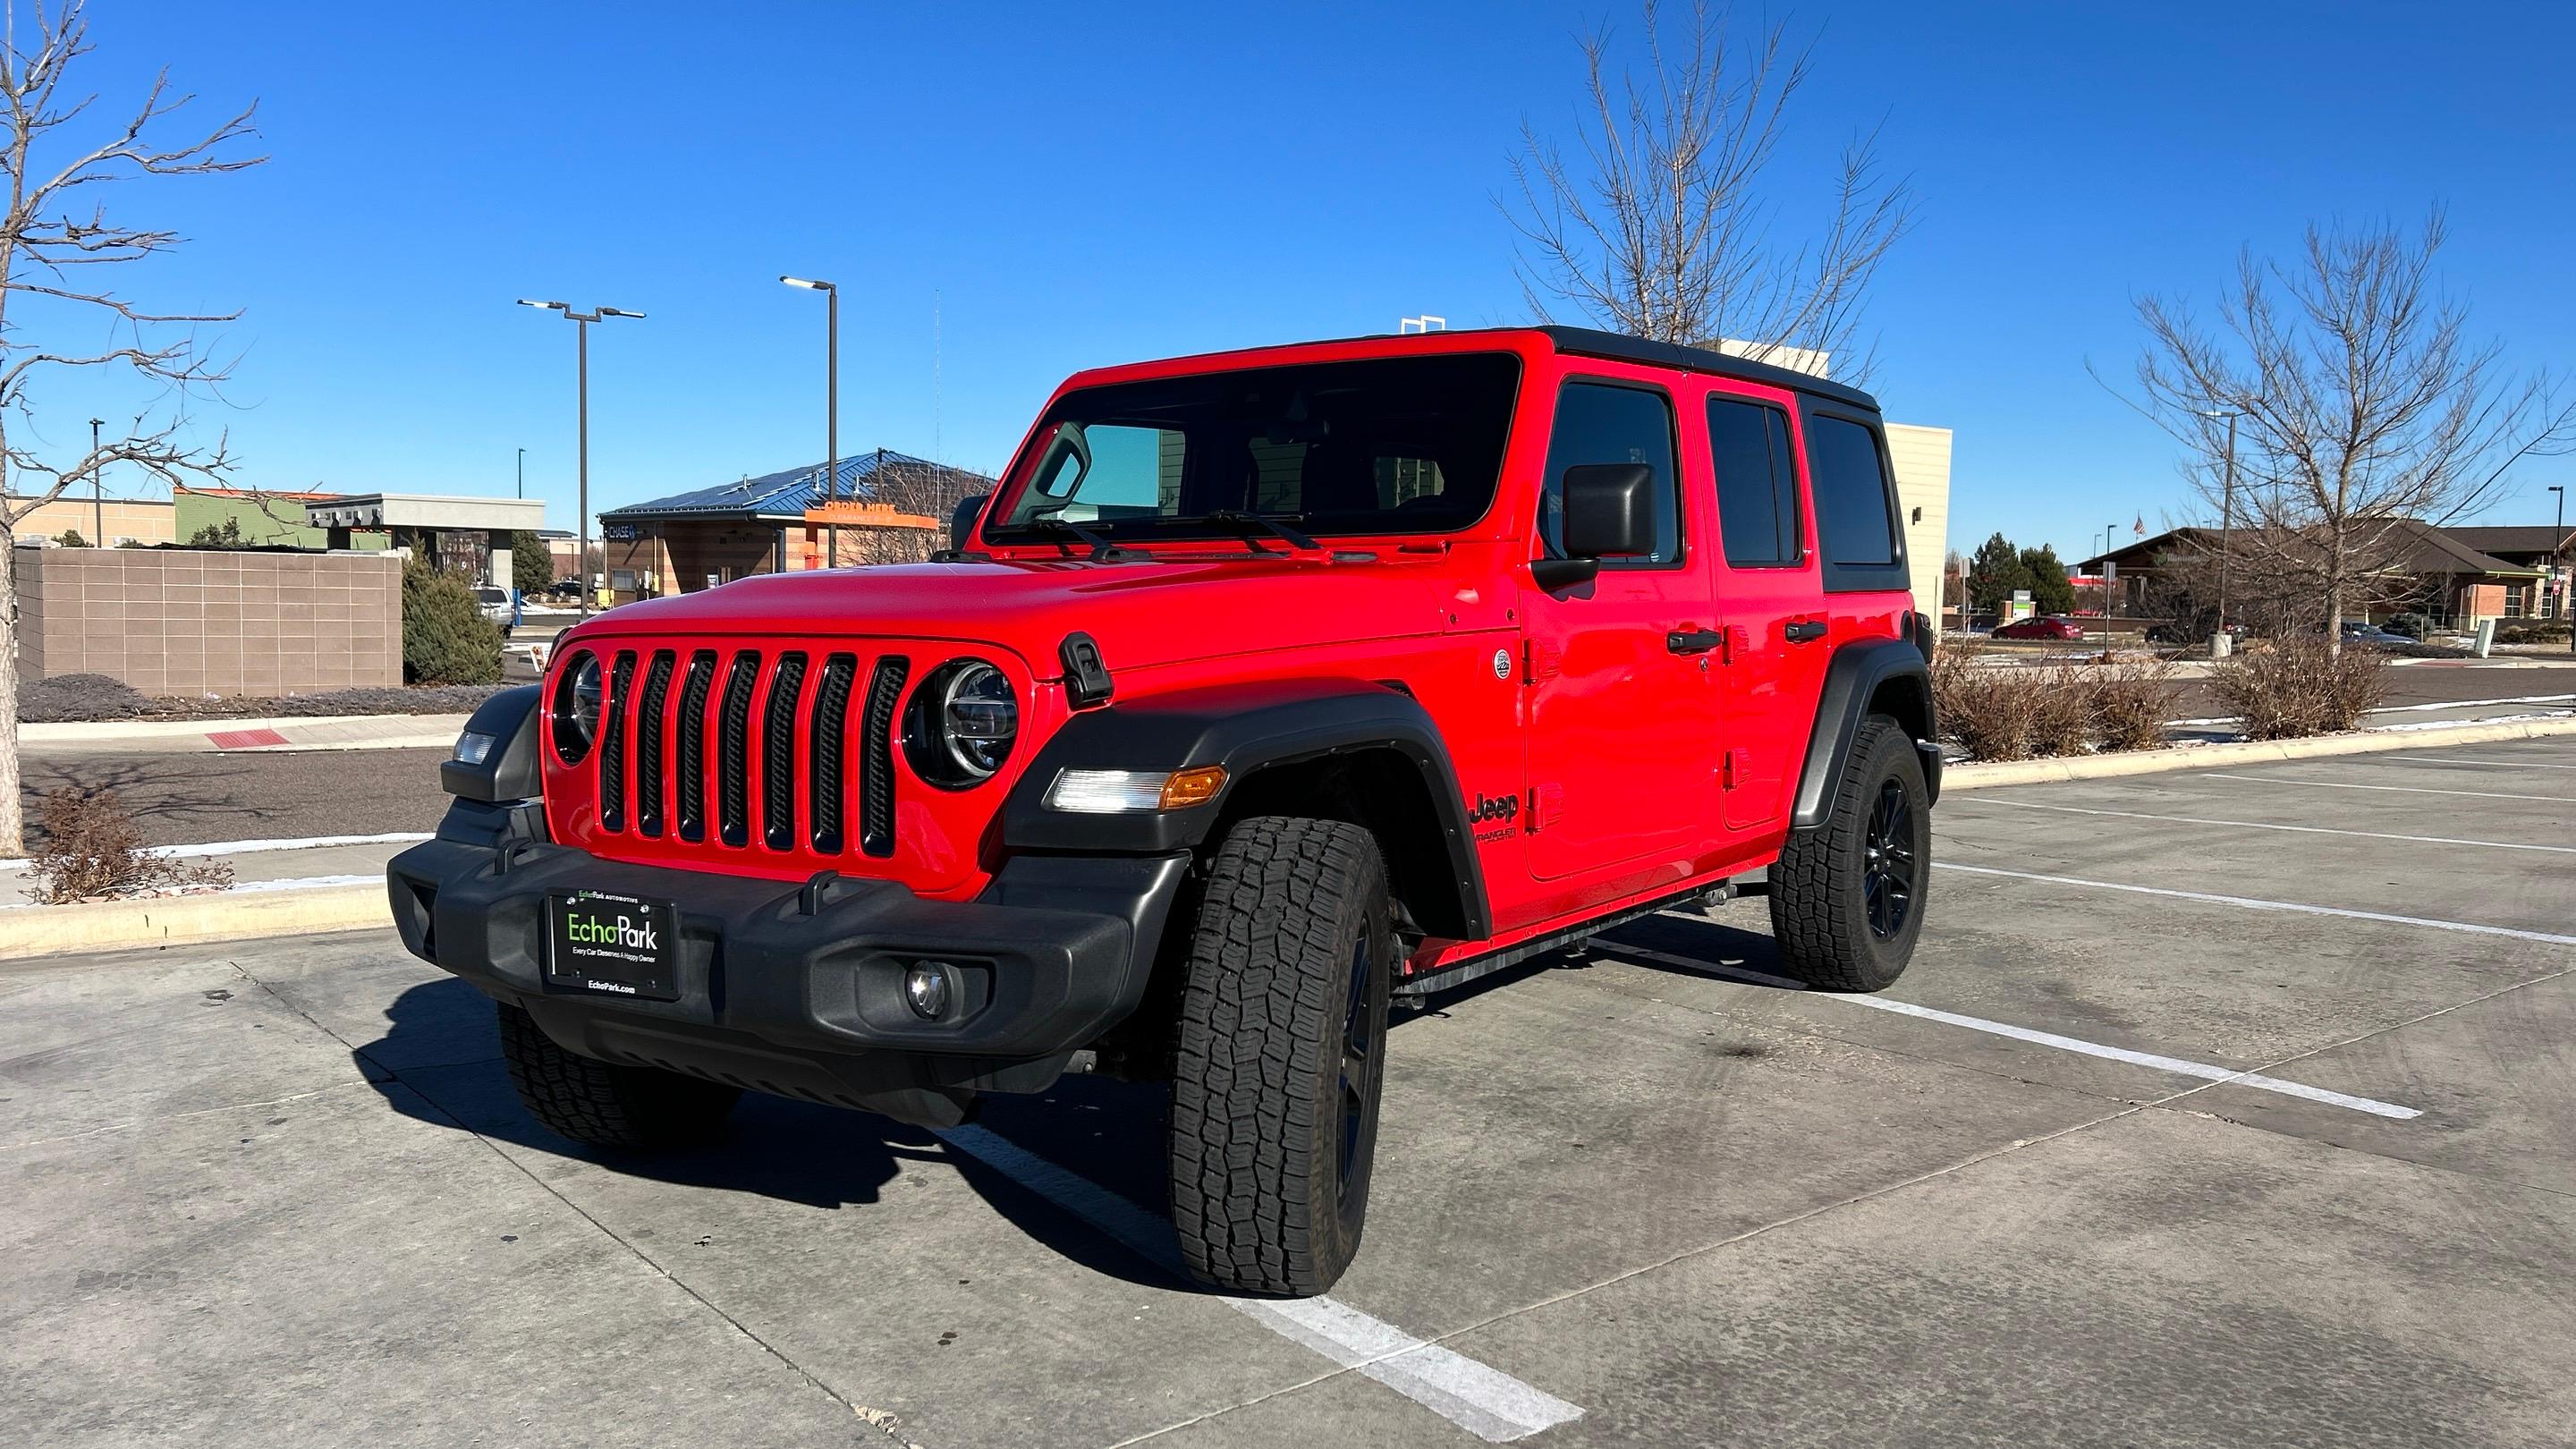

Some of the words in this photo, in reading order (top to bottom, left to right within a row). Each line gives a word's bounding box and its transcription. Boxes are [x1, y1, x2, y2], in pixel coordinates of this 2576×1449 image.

[825, 501, 863, 513] ORDER
[867, 503, 895, 515] HERE
[609, 525, 629, 538] CHASE
[1470, 793, 1518, 824] Jeep
[568, 912, 657, 950] EchoPark
[572, 946, 587, 956] Every
[587, 948, 597, 956] Car
[597, 949, 620, 959] Deserves
[588, 980, 635, 994] EchoPark.com
